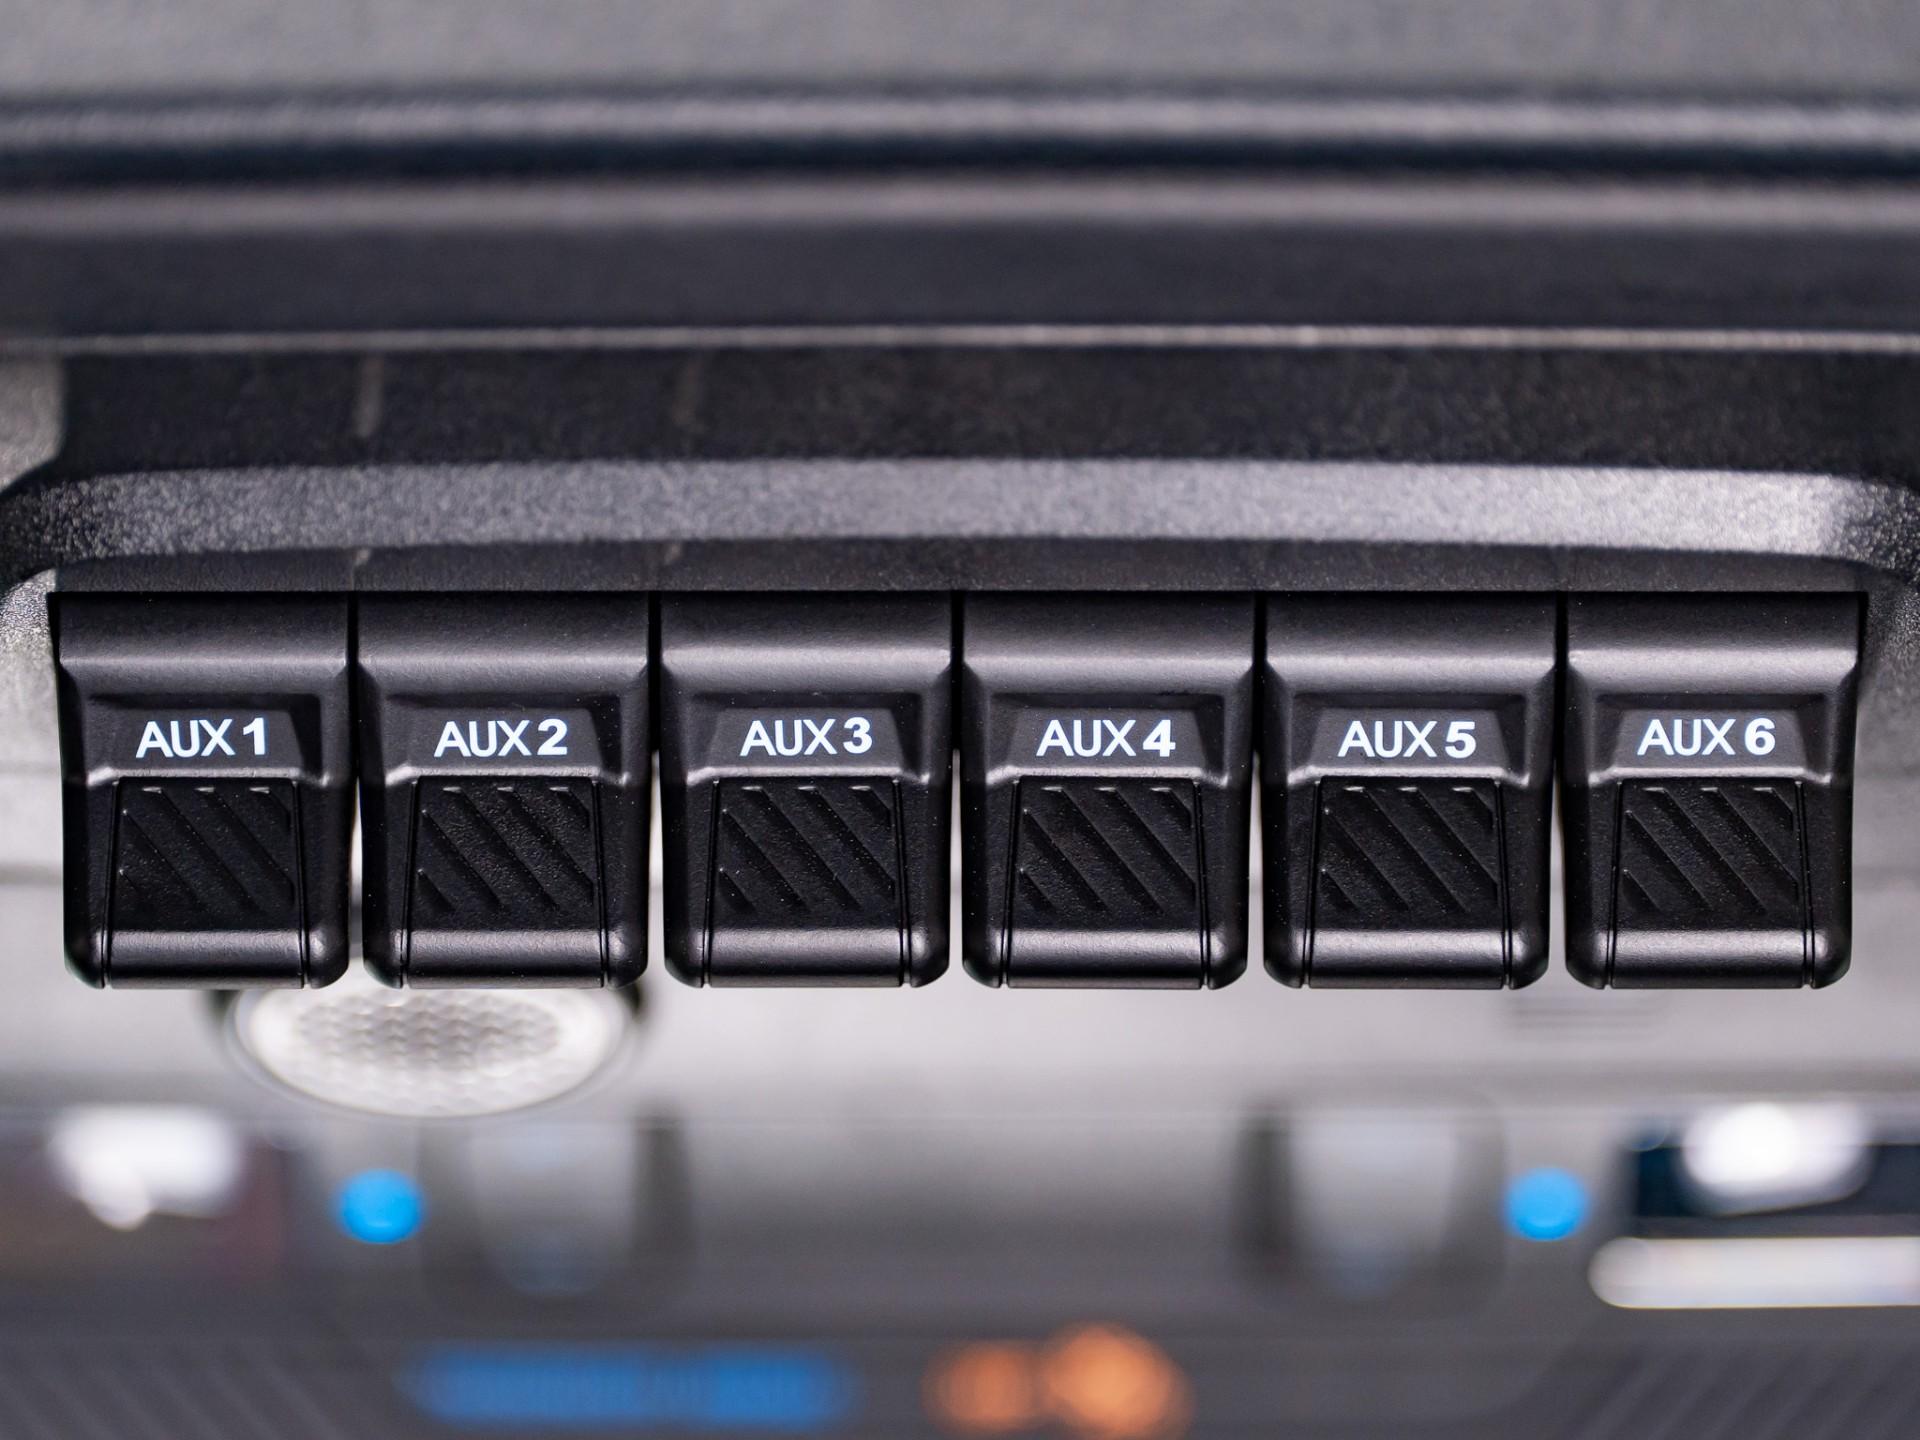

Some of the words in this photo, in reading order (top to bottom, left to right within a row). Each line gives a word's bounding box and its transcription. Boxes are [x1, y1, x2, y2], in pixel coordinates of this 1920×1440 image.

[135, 720, 233, 759] AUX
[242, 717, 266, 756] 1
[433, 720, 532, 758] AUX
[536, 716, 568, 756] 2
[740, 719, 838, 757] AUX
[842, 716, 873, 754] 3
[1035, 719, 1137, 757] AUX
[1142, 719, 1177, 757] 4
[1337, 720, 1438, 758] AUX
[1444, 720, 1477, 759] 5
[1636, 718, 1737, 756] AUX
[1744, 717, 1776, 756] 6
